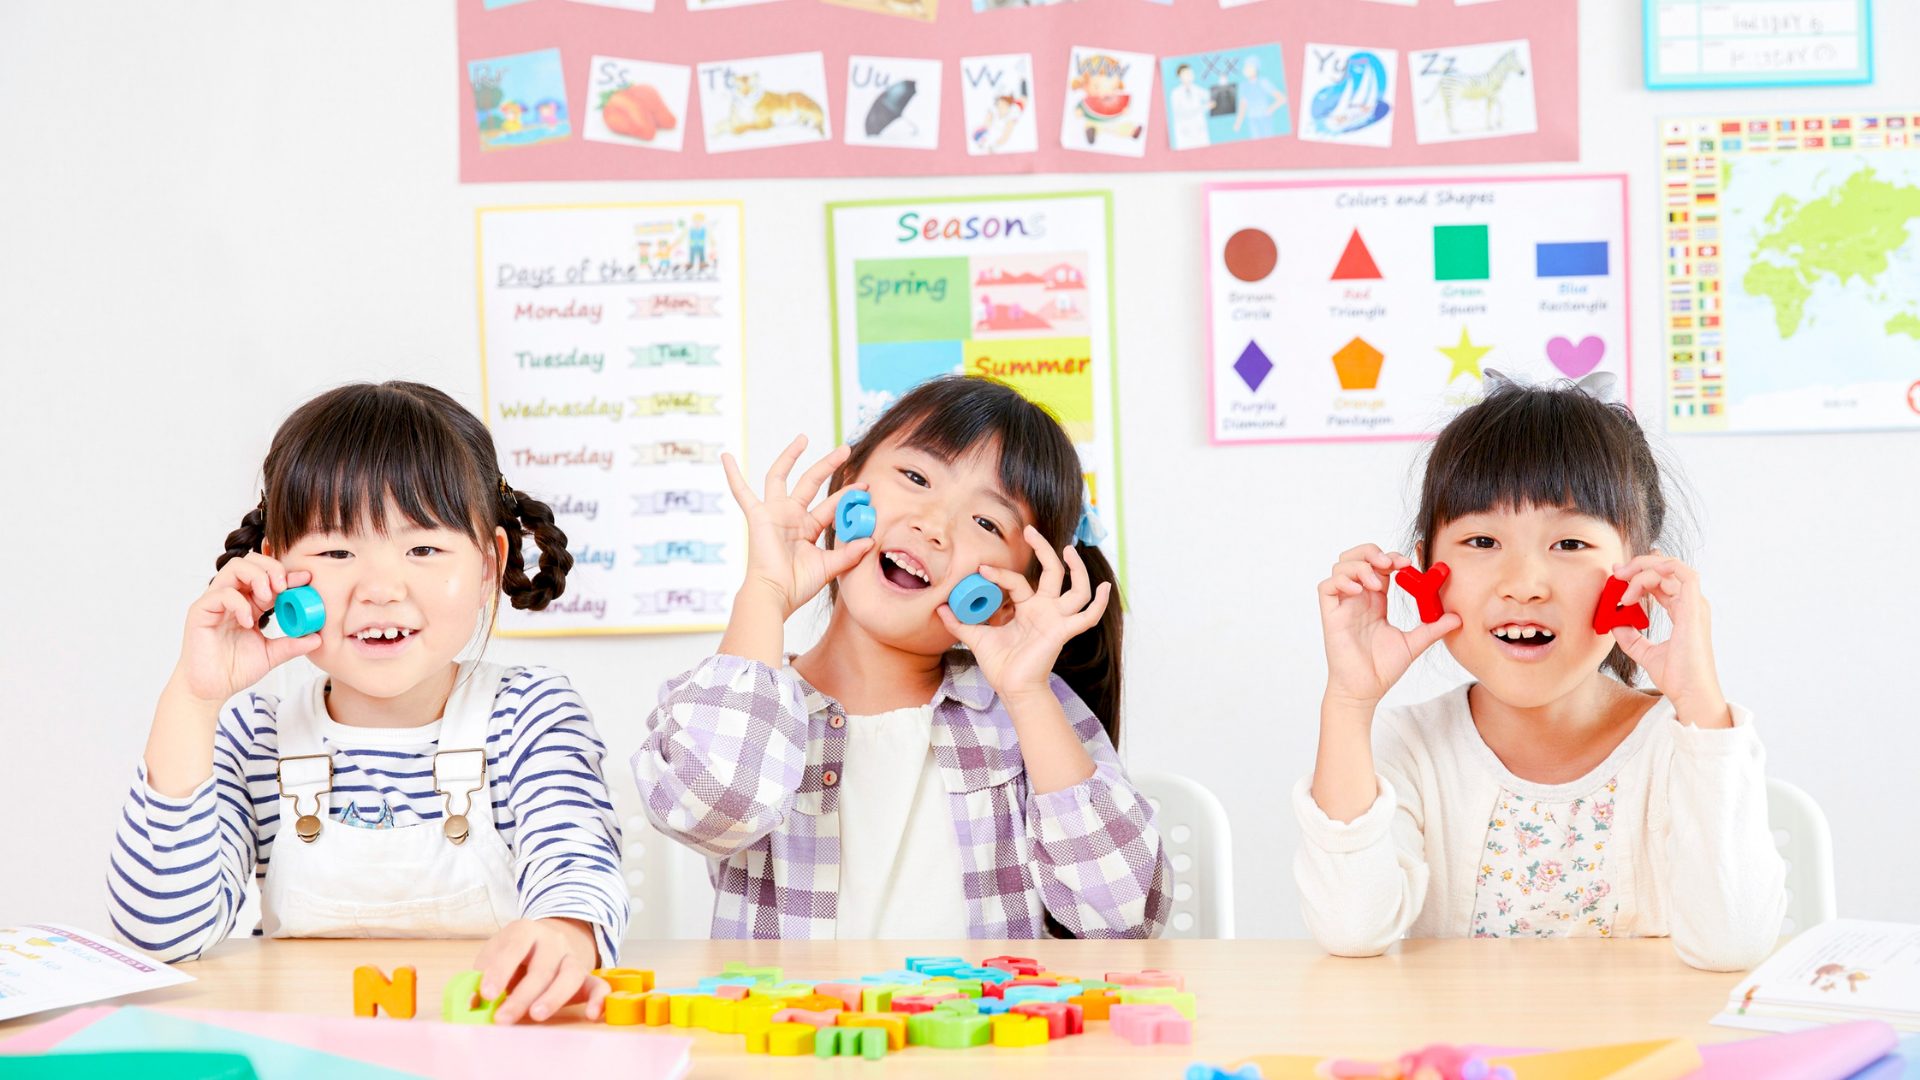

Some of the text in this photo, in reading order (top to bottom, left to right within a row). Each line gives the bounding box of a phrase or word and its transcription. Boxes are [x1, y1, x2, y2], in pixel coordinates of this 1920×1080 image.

[473, 64, 510, 89] Rr
[597, 61, 630, 88] Ss
[852, 64, 889, 88] Uu
[1201, 54, 1239, 81] Xx
[1313, 49, 1351, 82] Yy
[1420, 53, 1459, 76] Zz
[702, 66, 736, 90] Tt
[1335, 188, 1495, 209] Colors and Shapes
[898, 212, 1046, 242] Seasons
[498, 264, 556, 288] Days
[566, 258, 591, 284] of
[598, 259, 637, 282] the
[858, 272, 948, 304] Spring
[1344, 288, 1371, 299] Red
[1442, 285, 1484, 298] Green
[1558, 283, 1587, 295] Blue
[513, 299, 604, 324] Monday
[1329, 305, 1387, 321] Triangle
[1439, 303, 1486, 316] Square
[1539, 299, 1607, 315] Rectangle
[515, 347, 604, 373] Tuesday
[974, 356, 1091, 377] Summer
[499, 396, 625, 422] Wednesday
[1231, 400, 1276, 415] Purple
[1333, 398, 1385, 414] Orange
[1222, 416, 1287, 430] Diamond
[1326, 414, 1393, 430] Pentagon
[512, 445, 614, 470] Thursday
[549, 495, 599, 519] iday
[1395, 561, 1449, 623] Y
[527, 594, 606, 619] nday
[1593, 574, 1650, 635] A
[354, 964, 417, 1020] N
